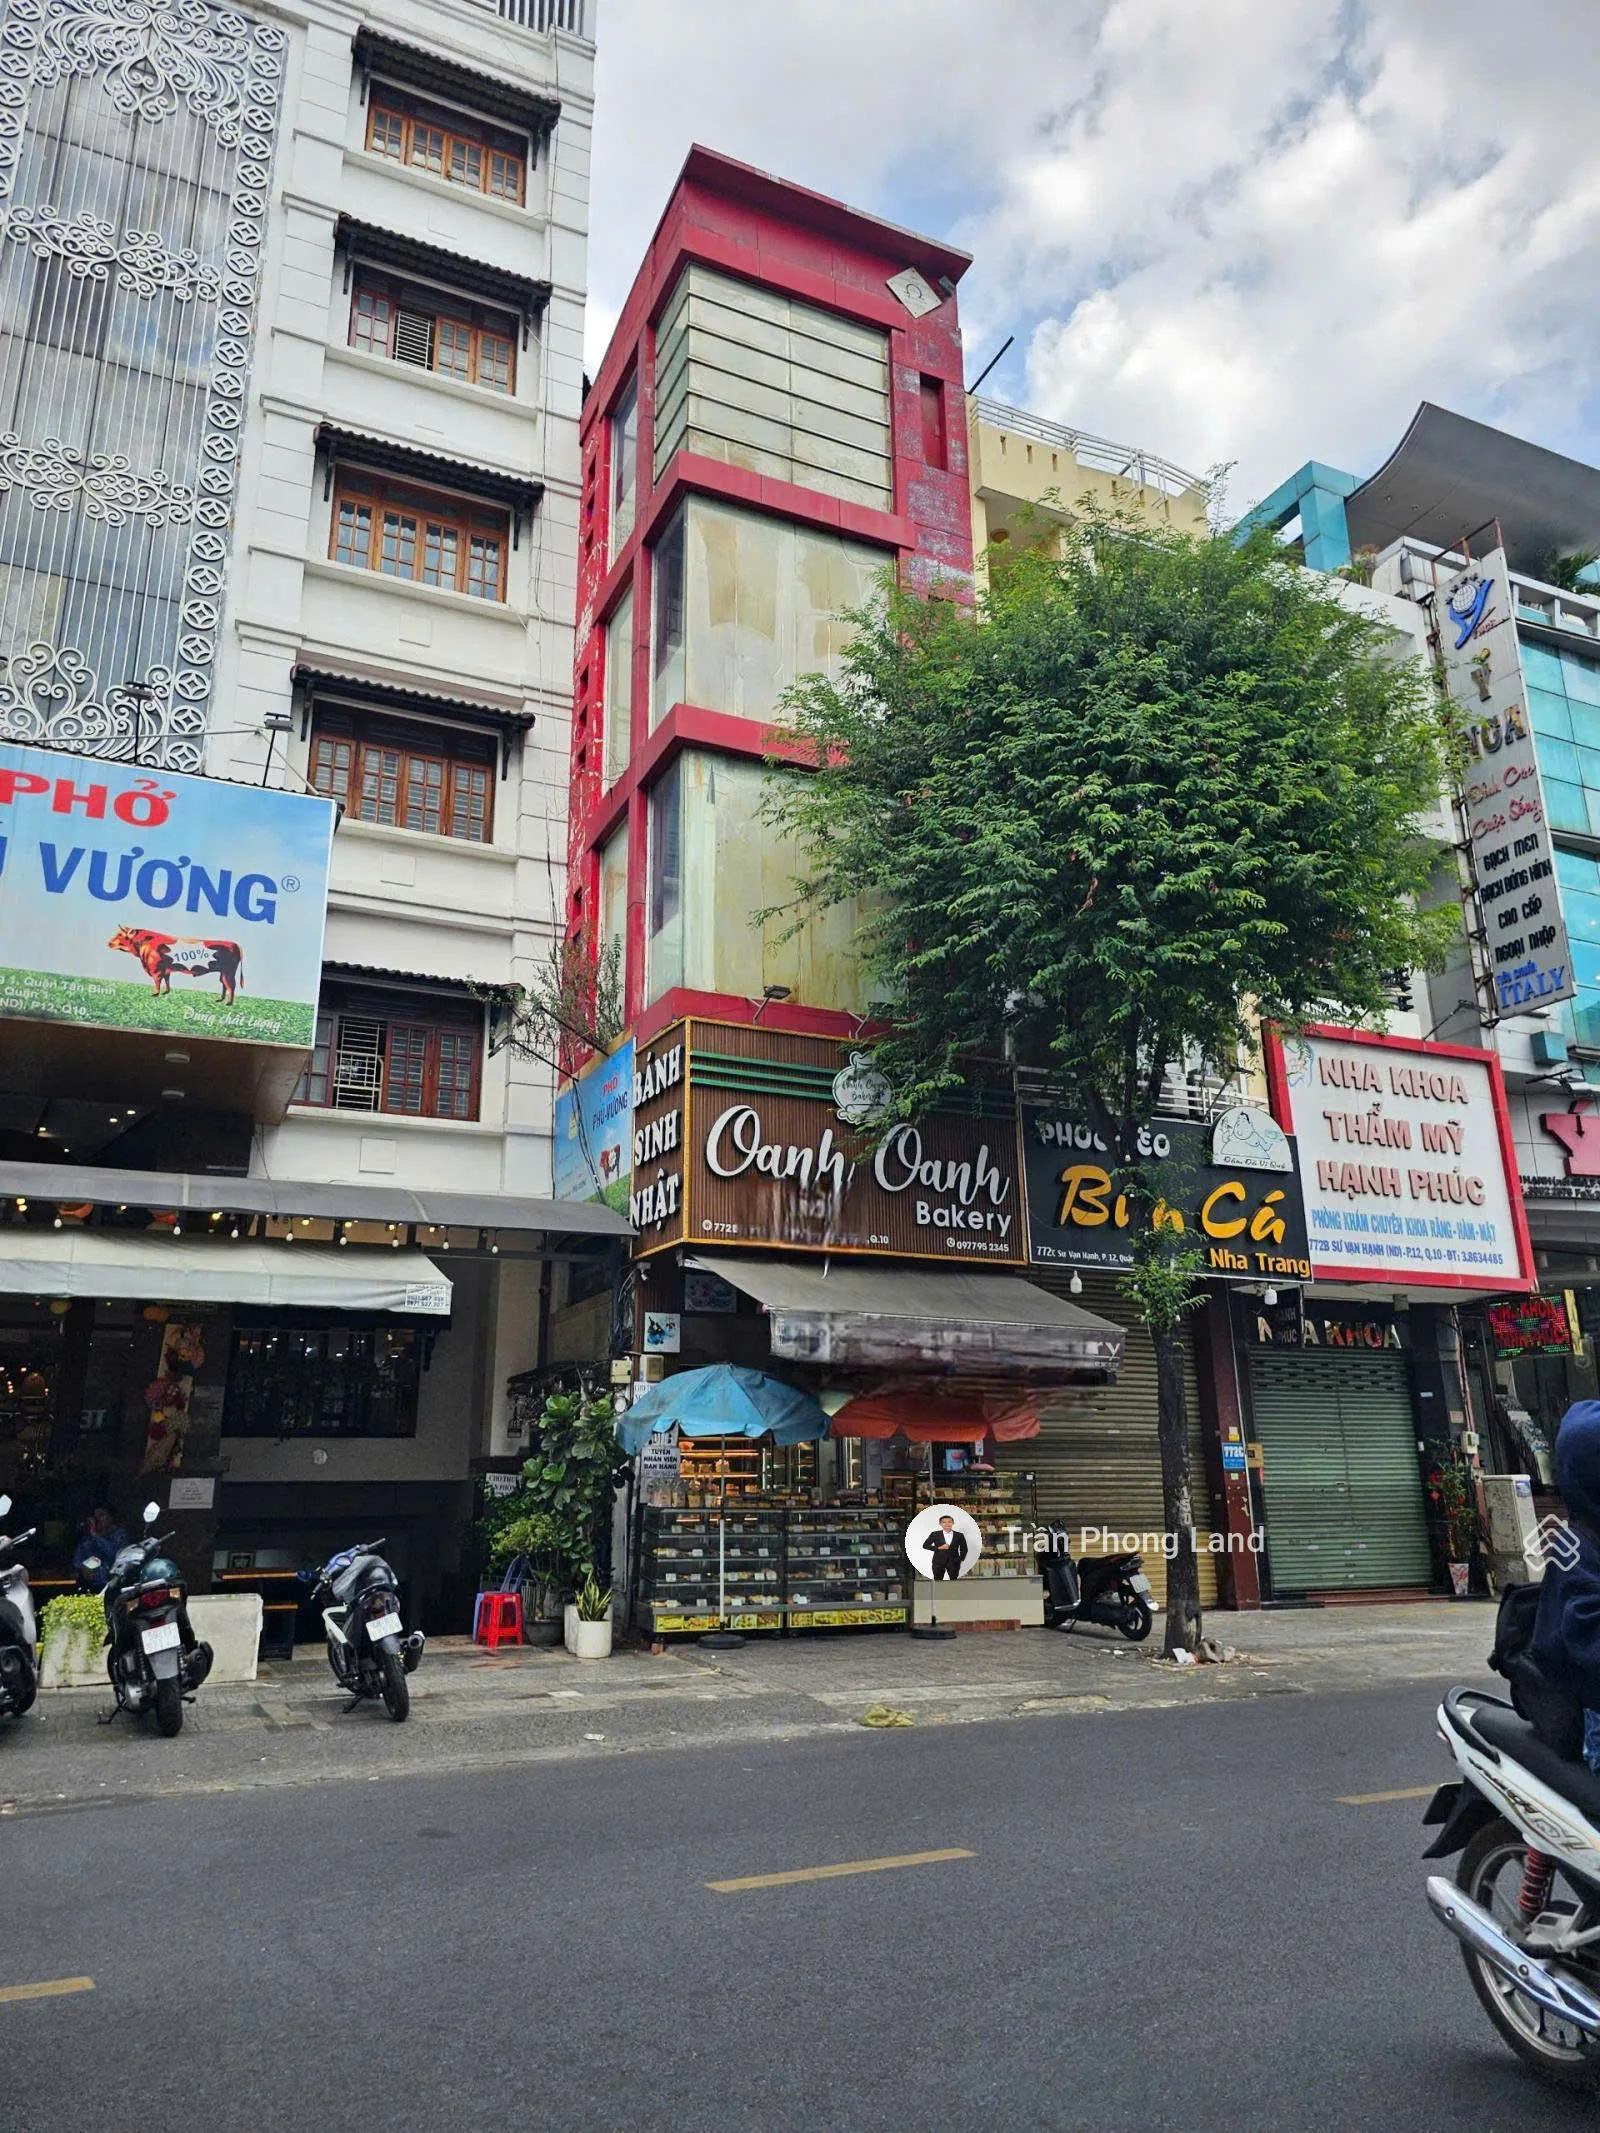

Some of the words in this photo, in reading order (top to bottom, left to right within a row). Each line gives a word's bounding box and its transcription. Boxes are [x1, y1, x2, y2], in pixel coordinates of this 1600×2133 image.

[0, 767, 176, 828] PHỞ
[40, 842, 278, 924] VƯƠNG
[173, 948, 209, 962] 100%
[1500, 965, 1565, 1009] ITALY
[632, 1044, 681, 1109] BÁNH
[1319, 1056, 1383, 1093] NHA
[1389, 1066, 1470, 1104] KHOA
[635, 1109, 679, 1167] SINH
[1322, 1102, 1413, 1150] THẨM
[1420, 1119, 1466, 1156] MỸ
[874, 1122, 1010, 1205] Oanh
[1317, 1160, 1402, 1200] HẠNH
[1408, 1165, 1487, 1206] PHÚC
[629, 1167, 679, 1231] NHẬT
[916, 1200, 1011, 1237] Bakery
[1201, 1181, 1286, 1244] Cá
[1311, 1206, 1342, 1230] PHÒNG
[1343, 1209, 1369, 1233] KHÁM
[1405, 1217, 1428, 1237] KHOA
[1209, 1247, 1249, 1270] Nha
[1255, 1252, 1312, 1279] Trang
[1309, 1239, 1329, 1252] 772B
[1324, 1320, 1402, 1348] KHOA
